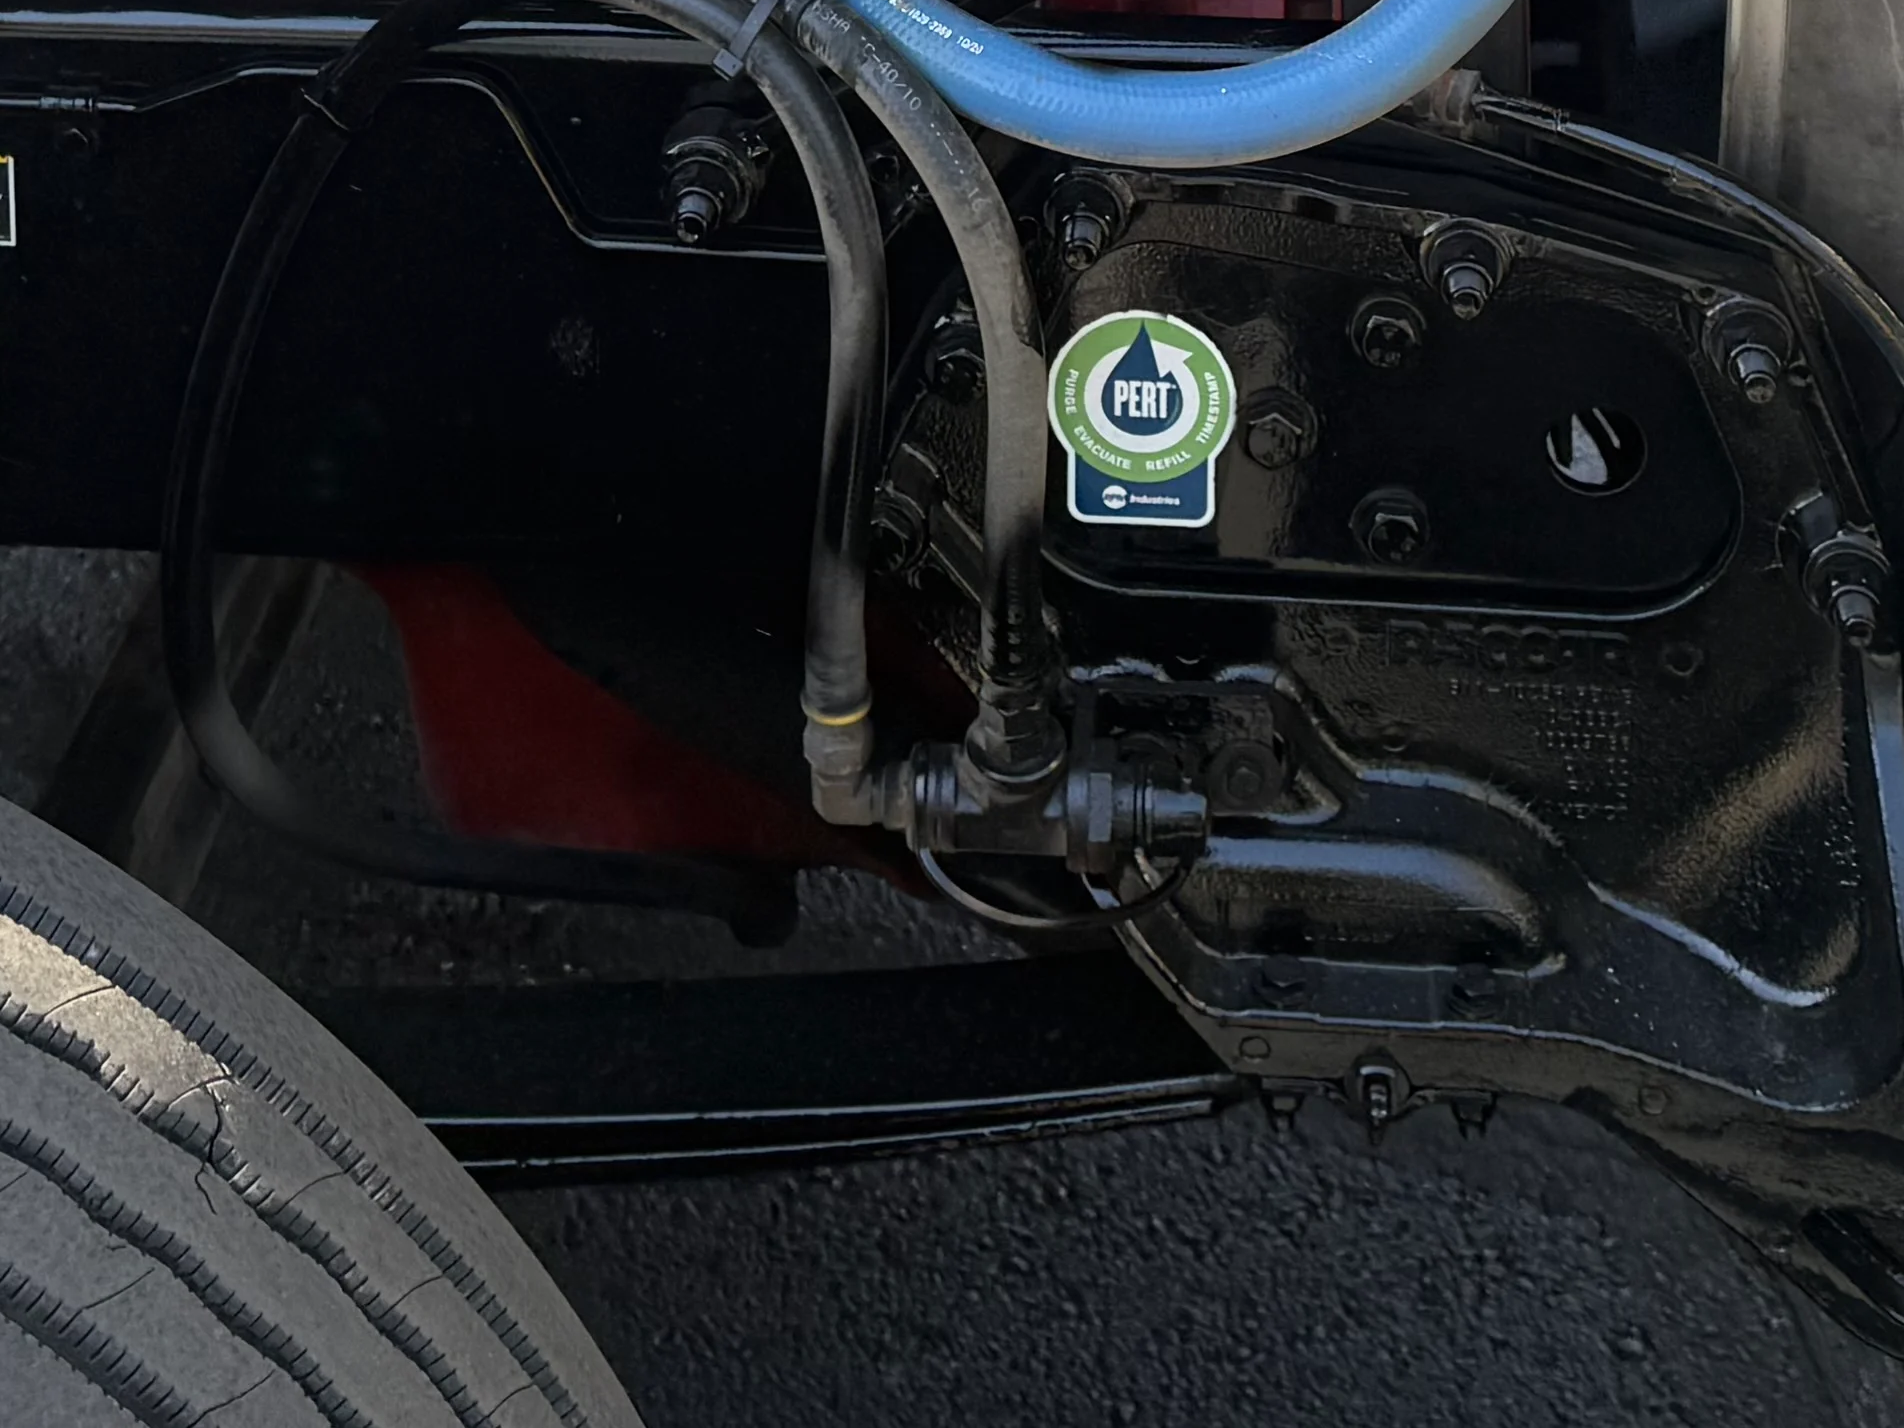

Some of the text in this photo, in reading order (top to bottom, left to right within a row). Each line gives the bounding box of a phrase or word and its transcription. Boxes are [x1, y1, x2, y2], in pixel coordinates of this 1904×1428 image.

[1063, 367, 1079, 415] PURGE
[1113, 379, 1172, 419] PERT
[1195, 371, 1222, 445] TIMESTAMP
[1073, 424, 1134, 471] EVACUATE
[1145, 450, 1193, 472] REFILL
